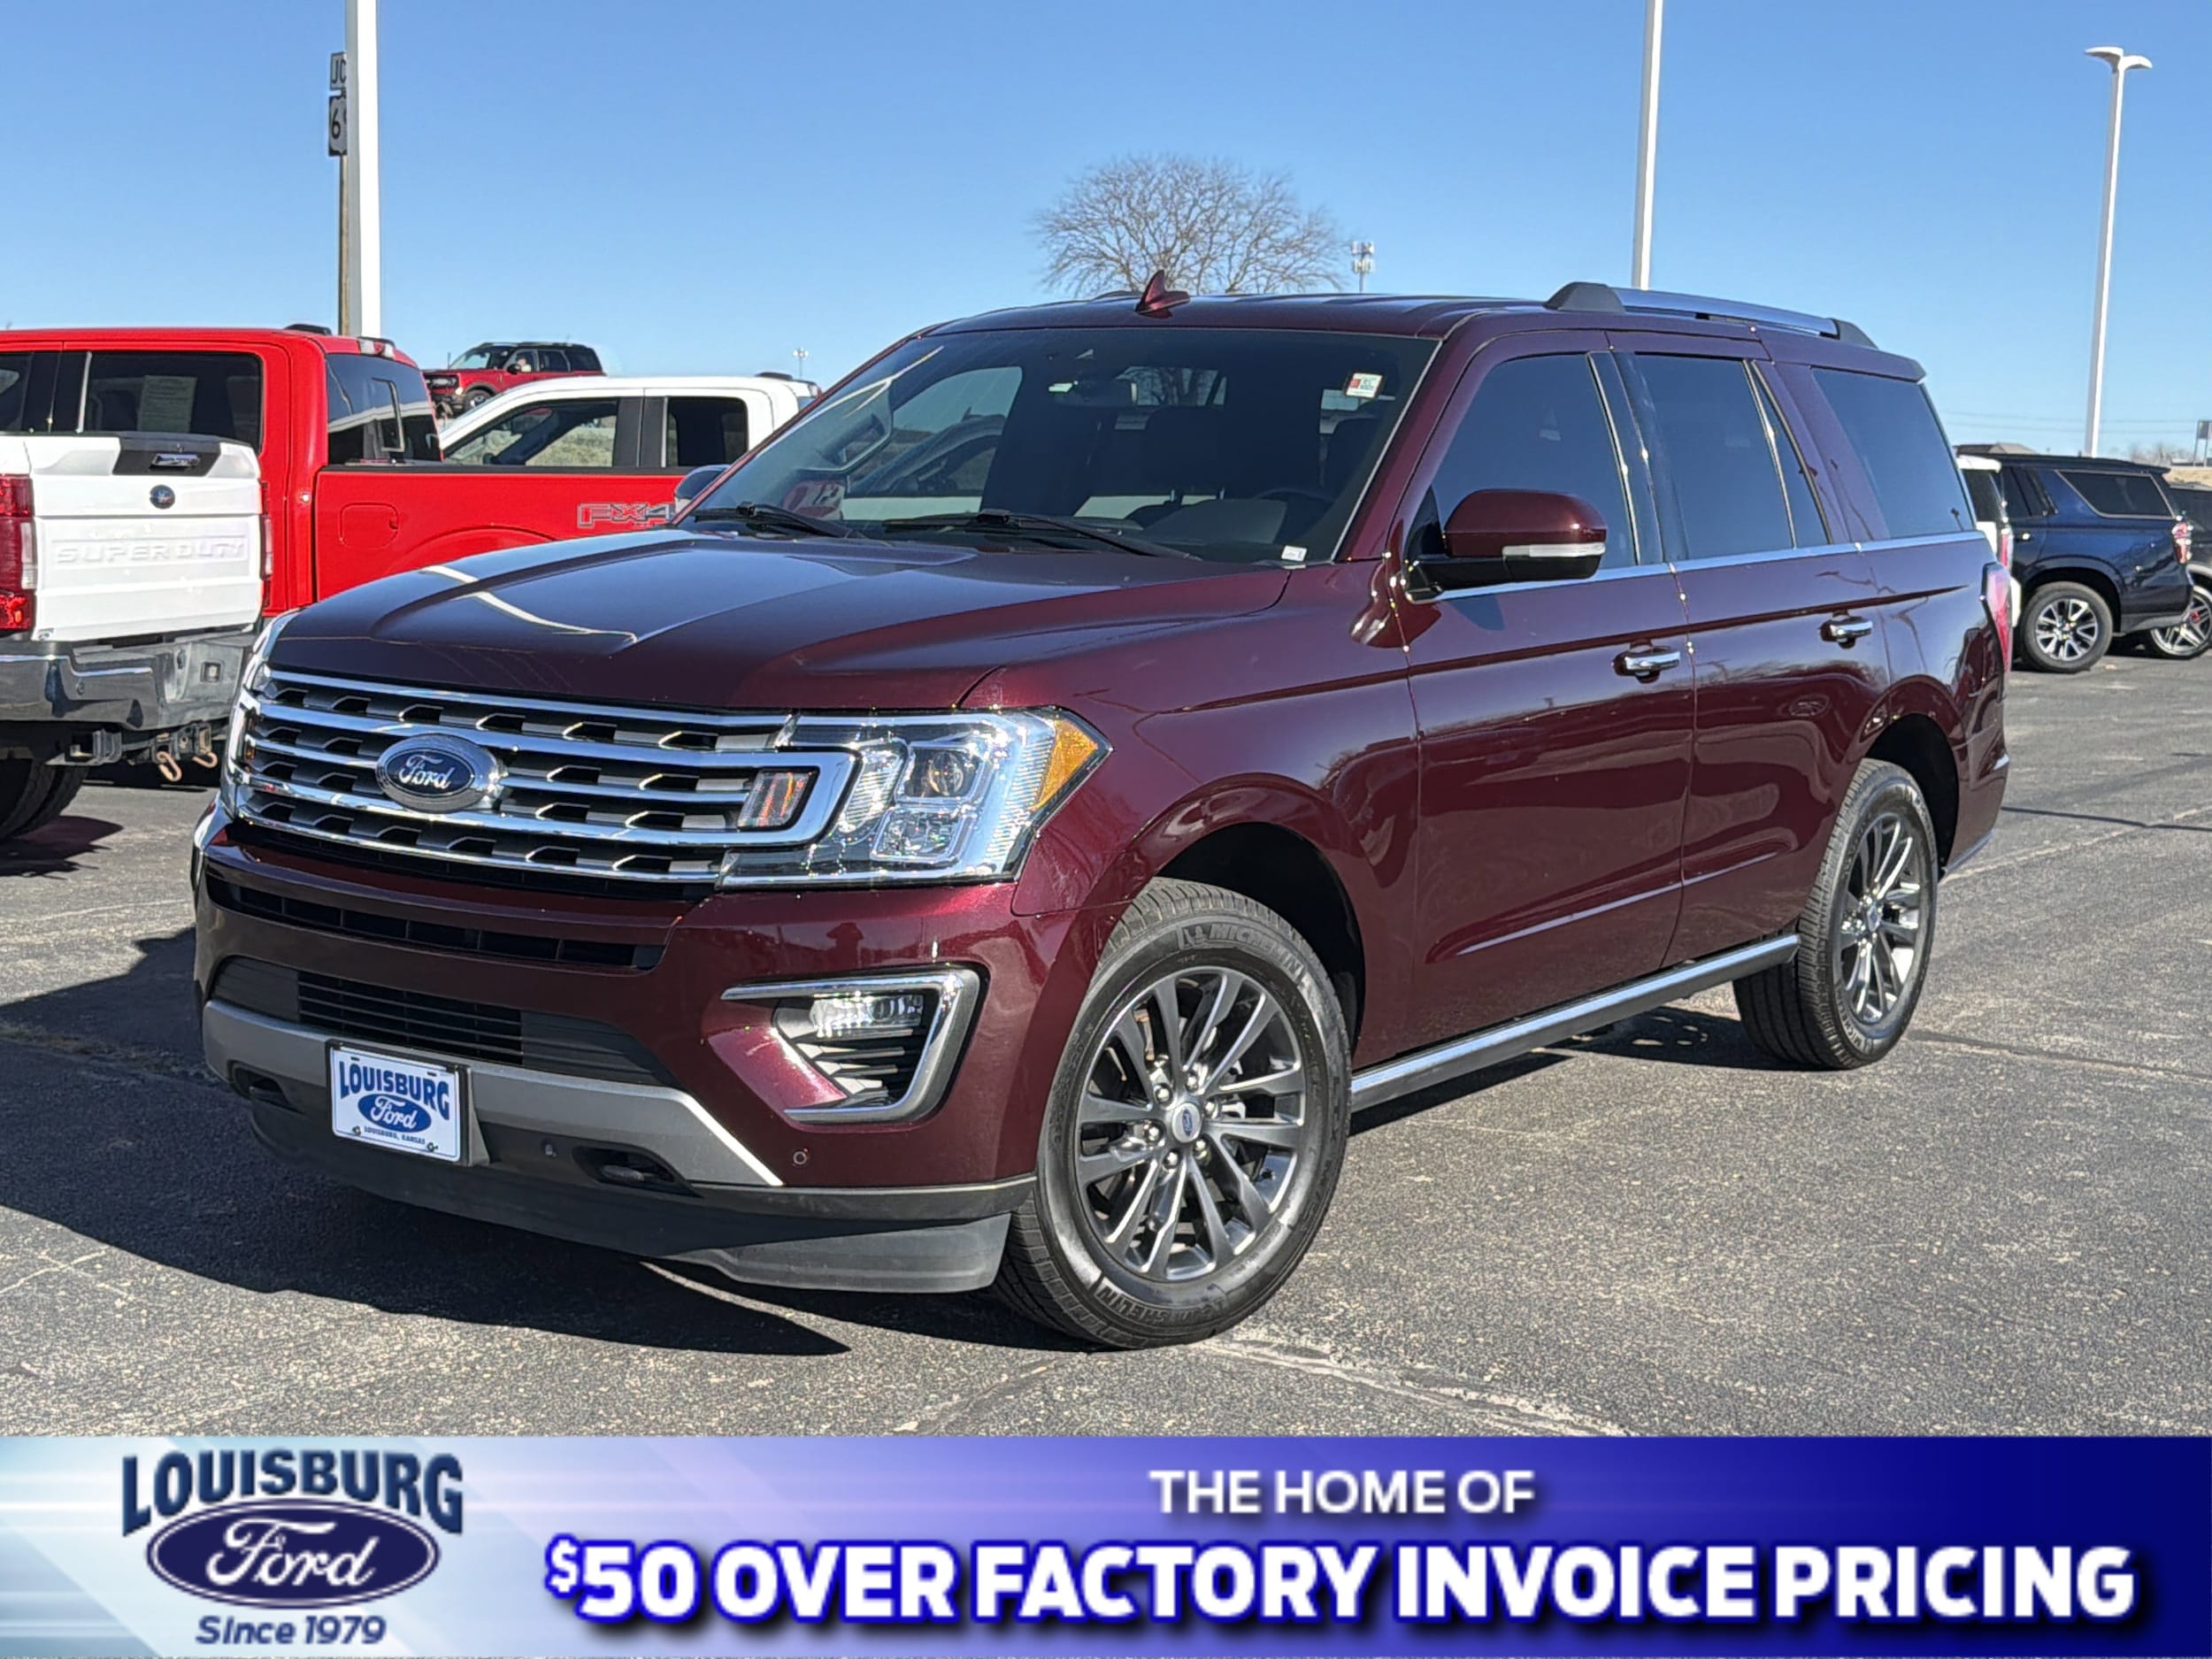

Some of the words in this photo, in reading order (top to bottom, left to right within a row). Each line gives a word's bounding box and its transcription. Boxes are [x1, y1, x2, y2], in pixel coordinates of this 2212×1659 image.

[332, 58, 347, 84] JC
[331, 107, 347, 140] 6
[577, 503, 674, 529] FX4
[56, 543, 170, 565] SUPER
[176, 541, 244, 559] DUTY
[398, 754, 455, 789] Ford
[339, 1061, 449, 1121] LOUISBURG
[370, 1095, 419, 1129] Ford
